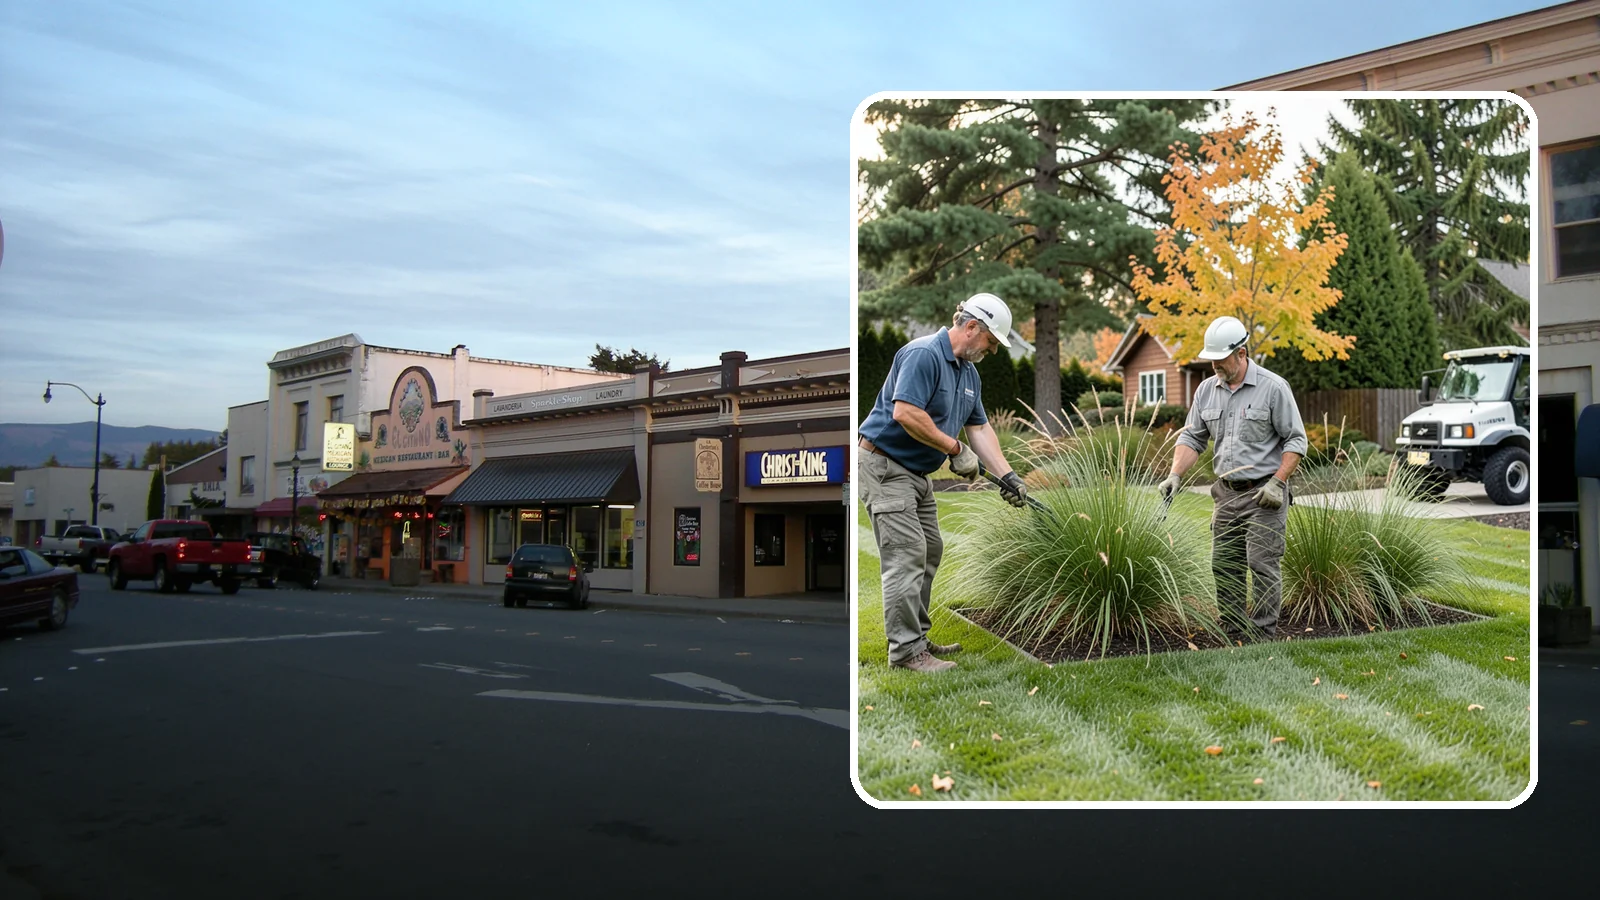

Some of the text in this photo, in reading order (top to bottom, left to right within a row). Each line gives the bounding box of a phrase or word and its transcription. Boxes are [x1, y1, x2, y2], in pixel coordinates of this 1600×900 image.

[493, 402, 522, 413] LAVANDERIA
[560, 394, 582, 404] Shop
[595, 389, 623, 400] LAUNDRY
[392, 425, 402, 449] EL
[373, 454, 396, 464] MEXICAN
[397, 451, 434, 462] RESTAURANT
[438, 449, 450, 459] BAR
[761, 450, 827, 478] CHRIST KING
